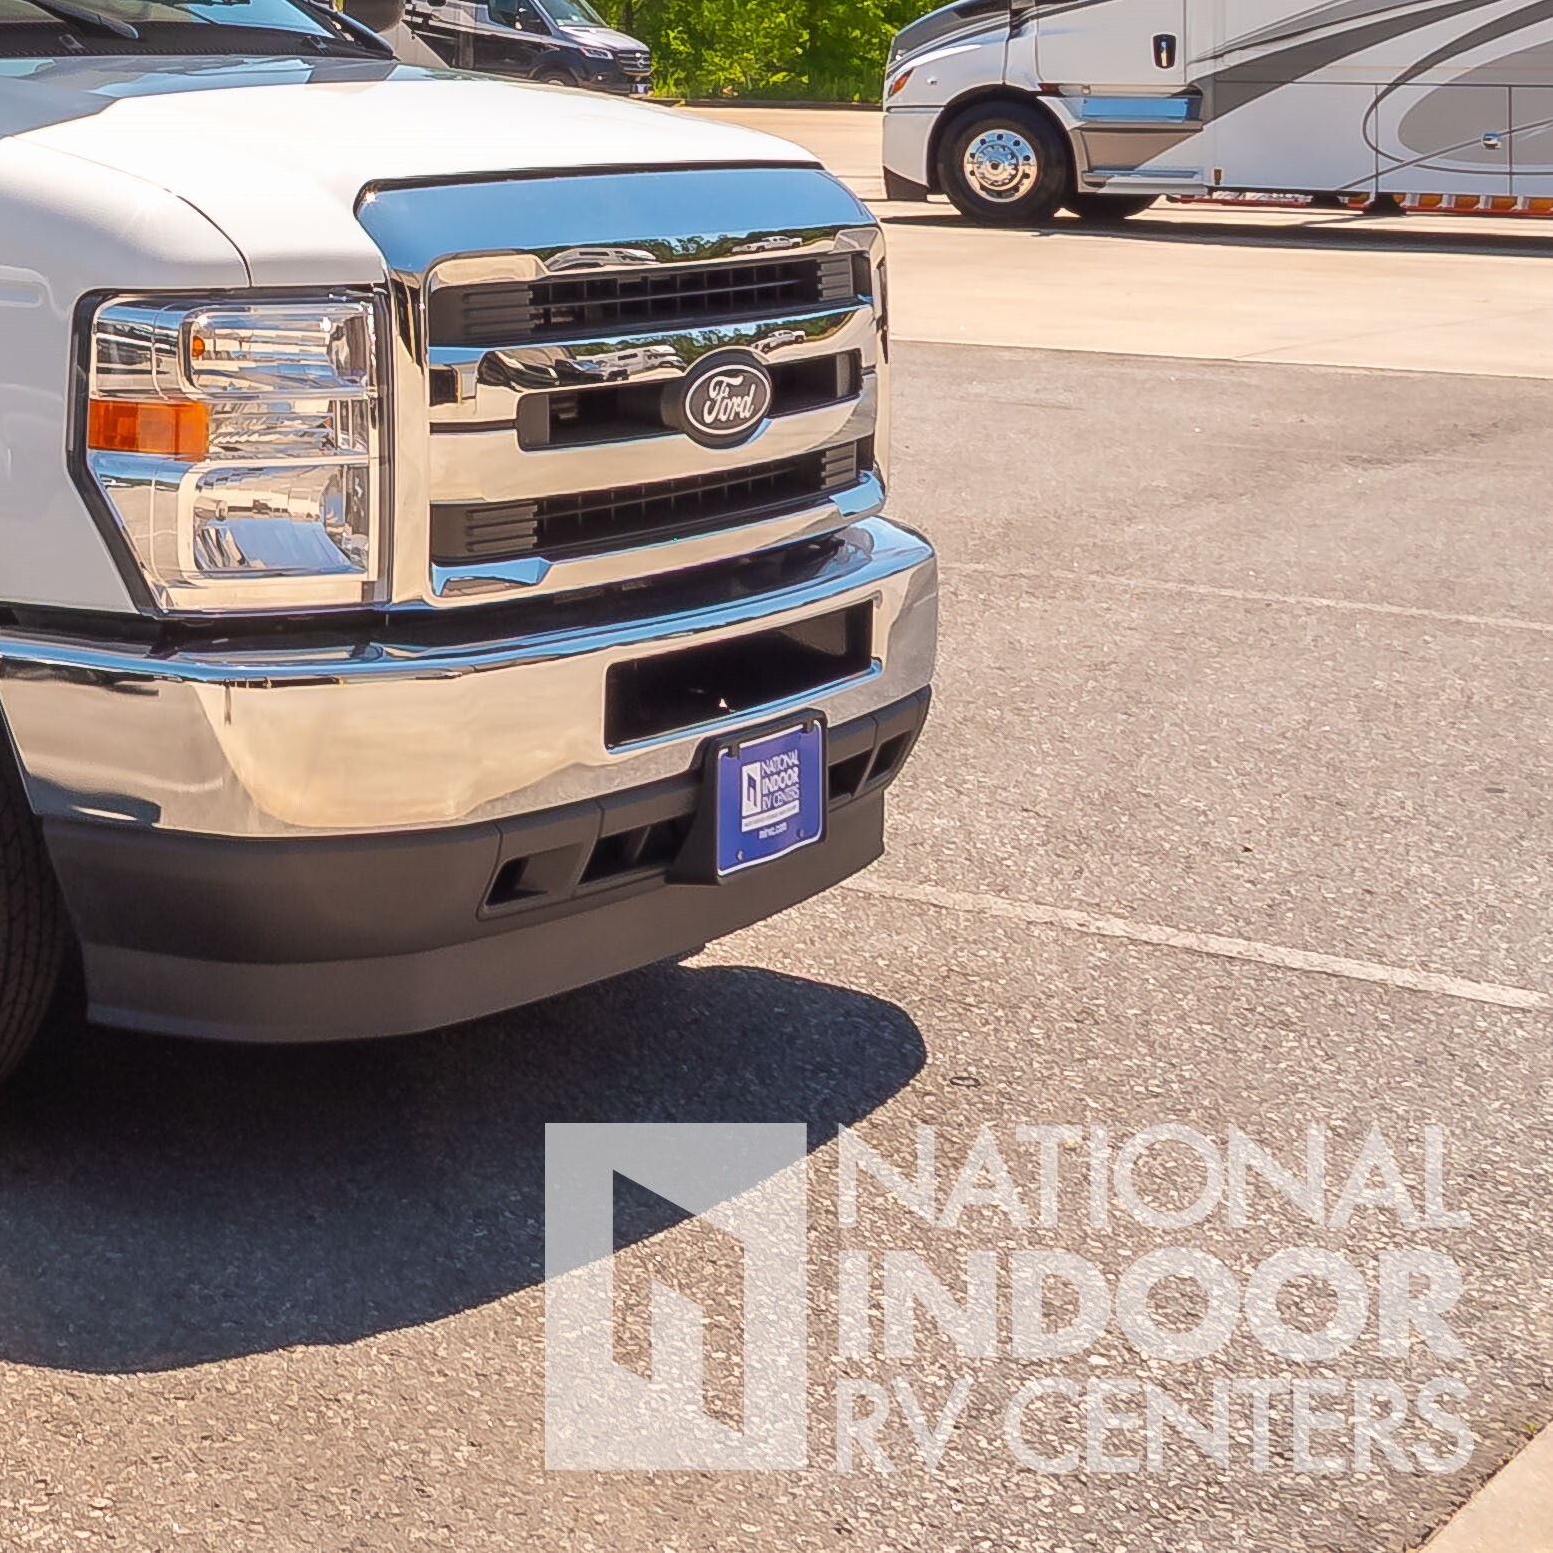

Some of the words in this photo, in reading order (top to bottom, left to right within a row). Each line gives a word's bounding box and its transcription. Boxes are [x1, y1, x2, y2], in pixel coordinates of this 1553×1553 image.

[703, 374, 756, 425] Ford
[761, 748, 800, 777] NATIONAL
[762, 766, 800, 796] INDOOR
[762, 794, 772, 811] RV
